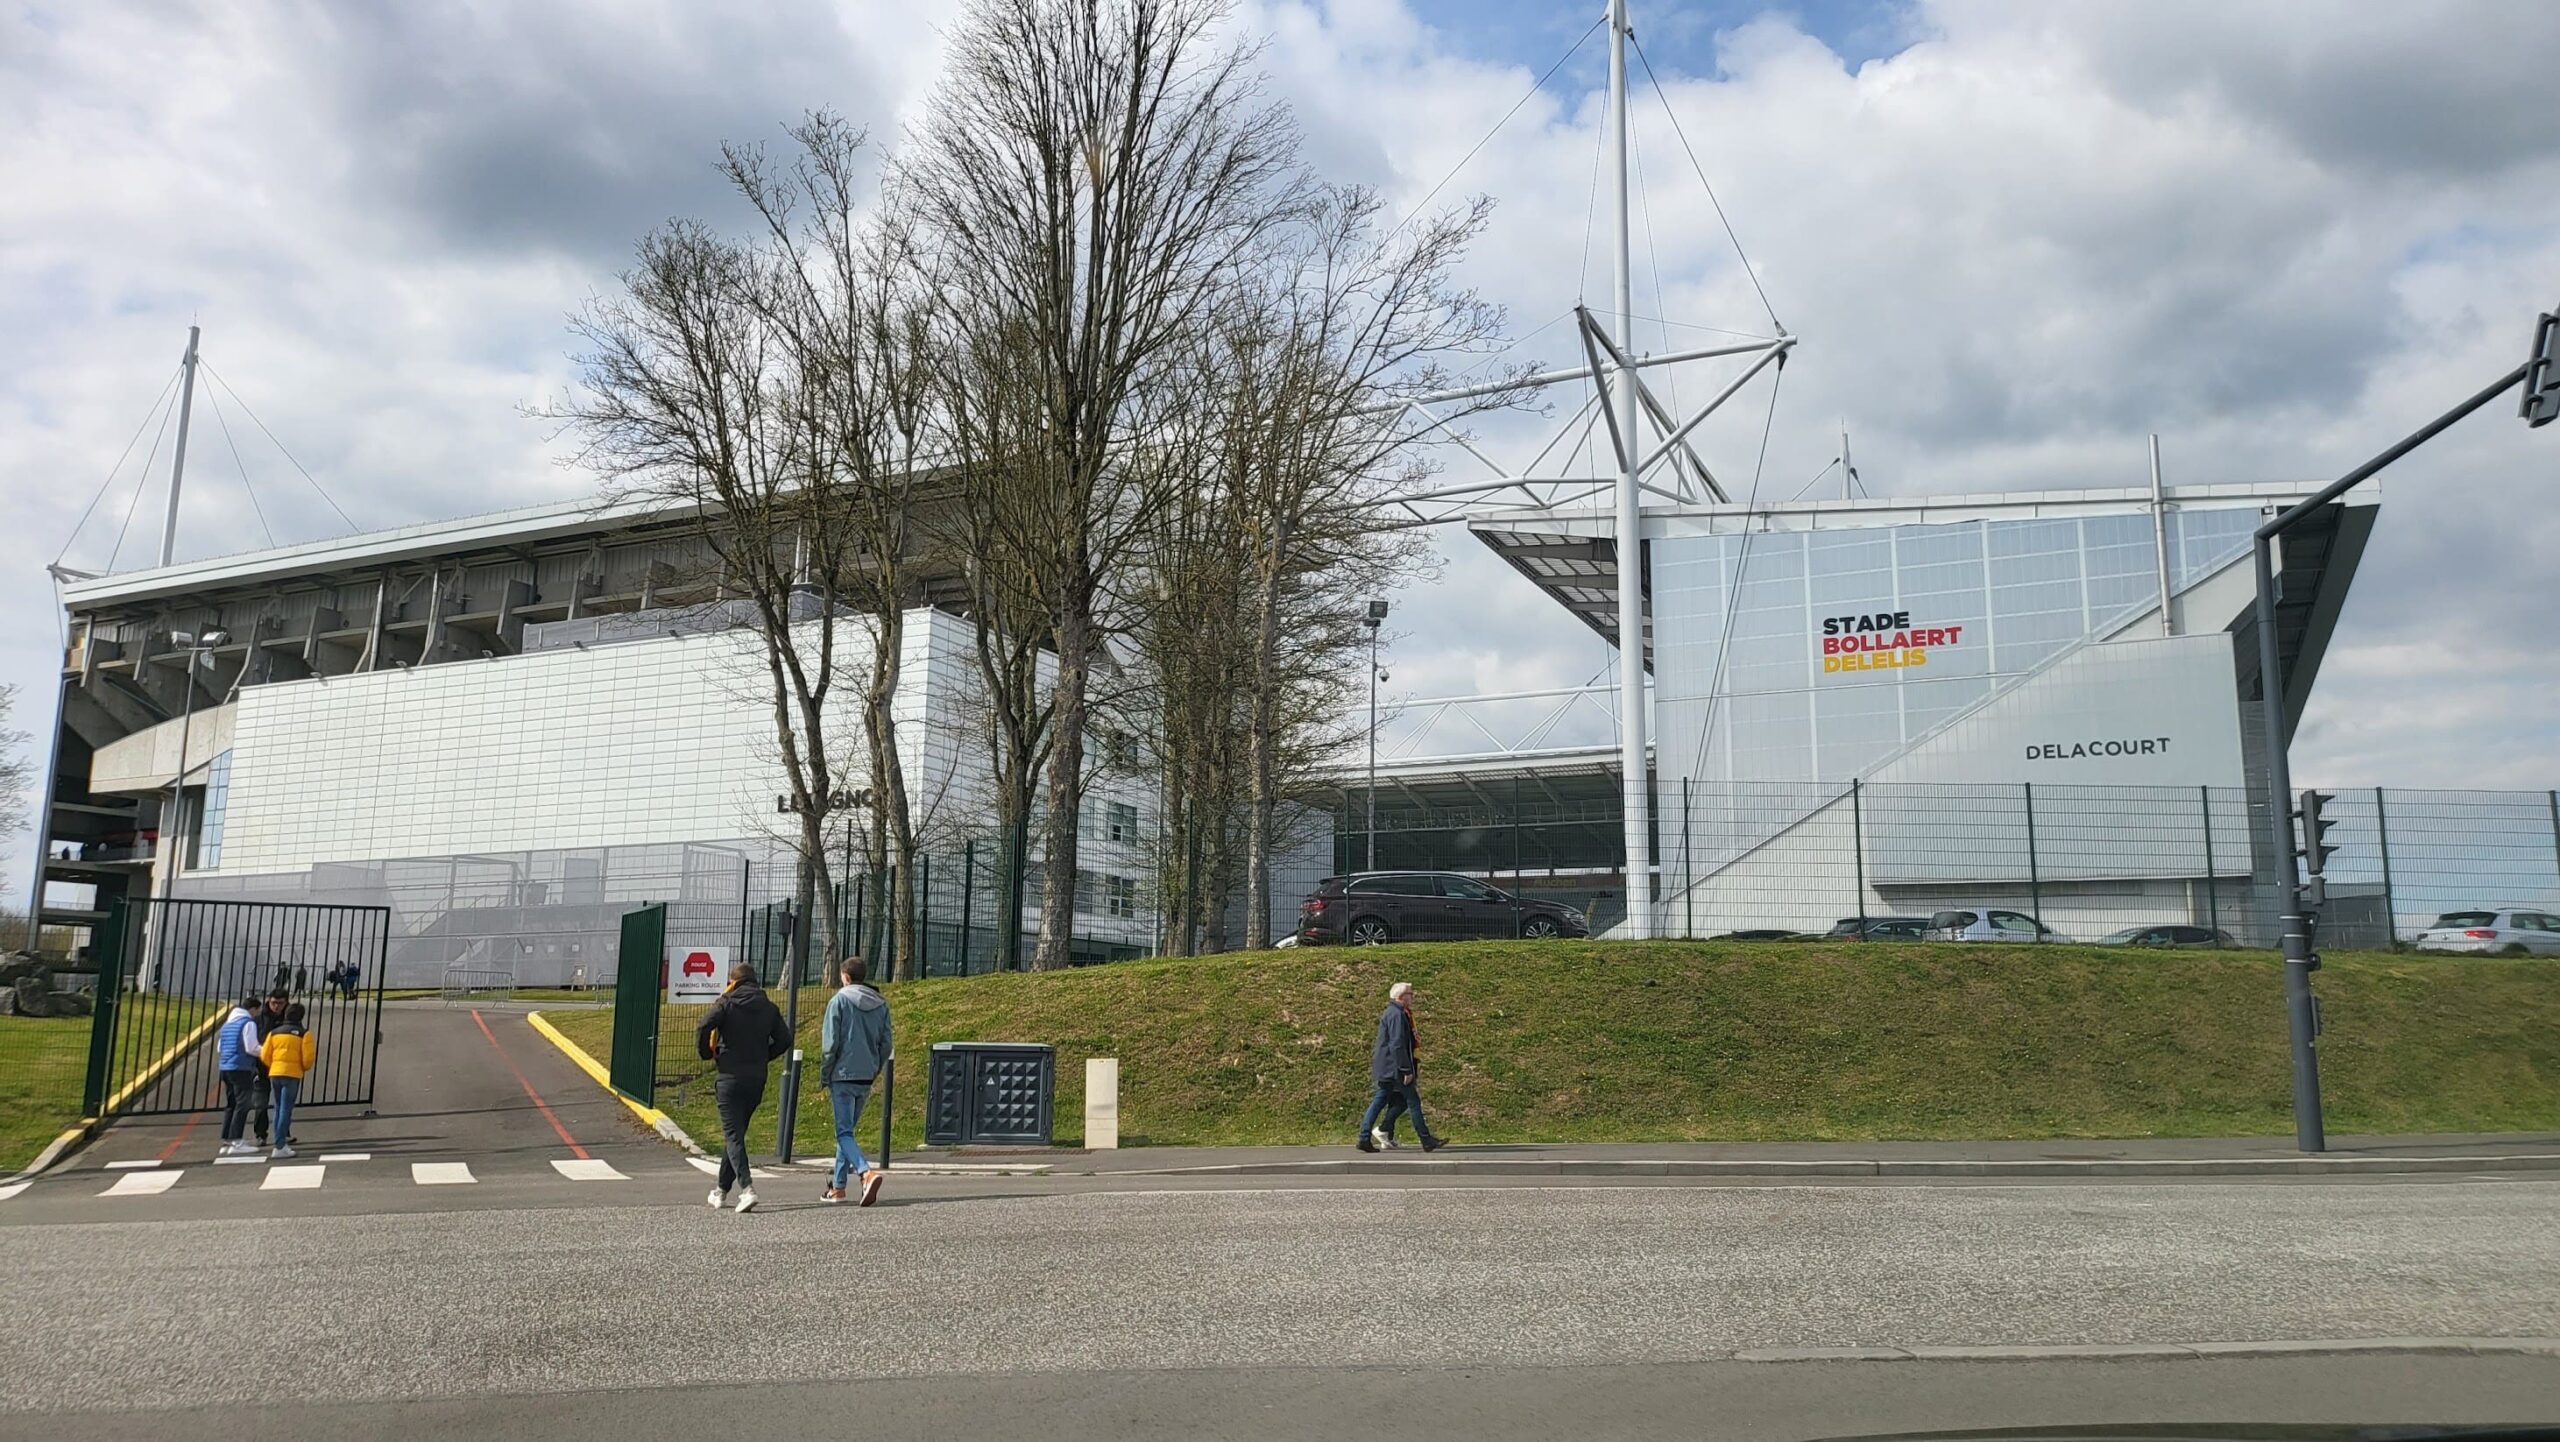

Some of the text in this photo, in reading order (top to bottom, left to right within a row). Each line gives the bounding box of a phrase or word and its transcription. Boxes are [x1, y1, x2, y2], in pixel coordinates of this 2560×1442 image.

[1823, 611, 1910, 636] STADE
[1823, 626, 1962, 655] BOLLAERT
[1823, 648, 1927, 673] DELELIS
[2026, 738, 2171, 760] DELACOURT
